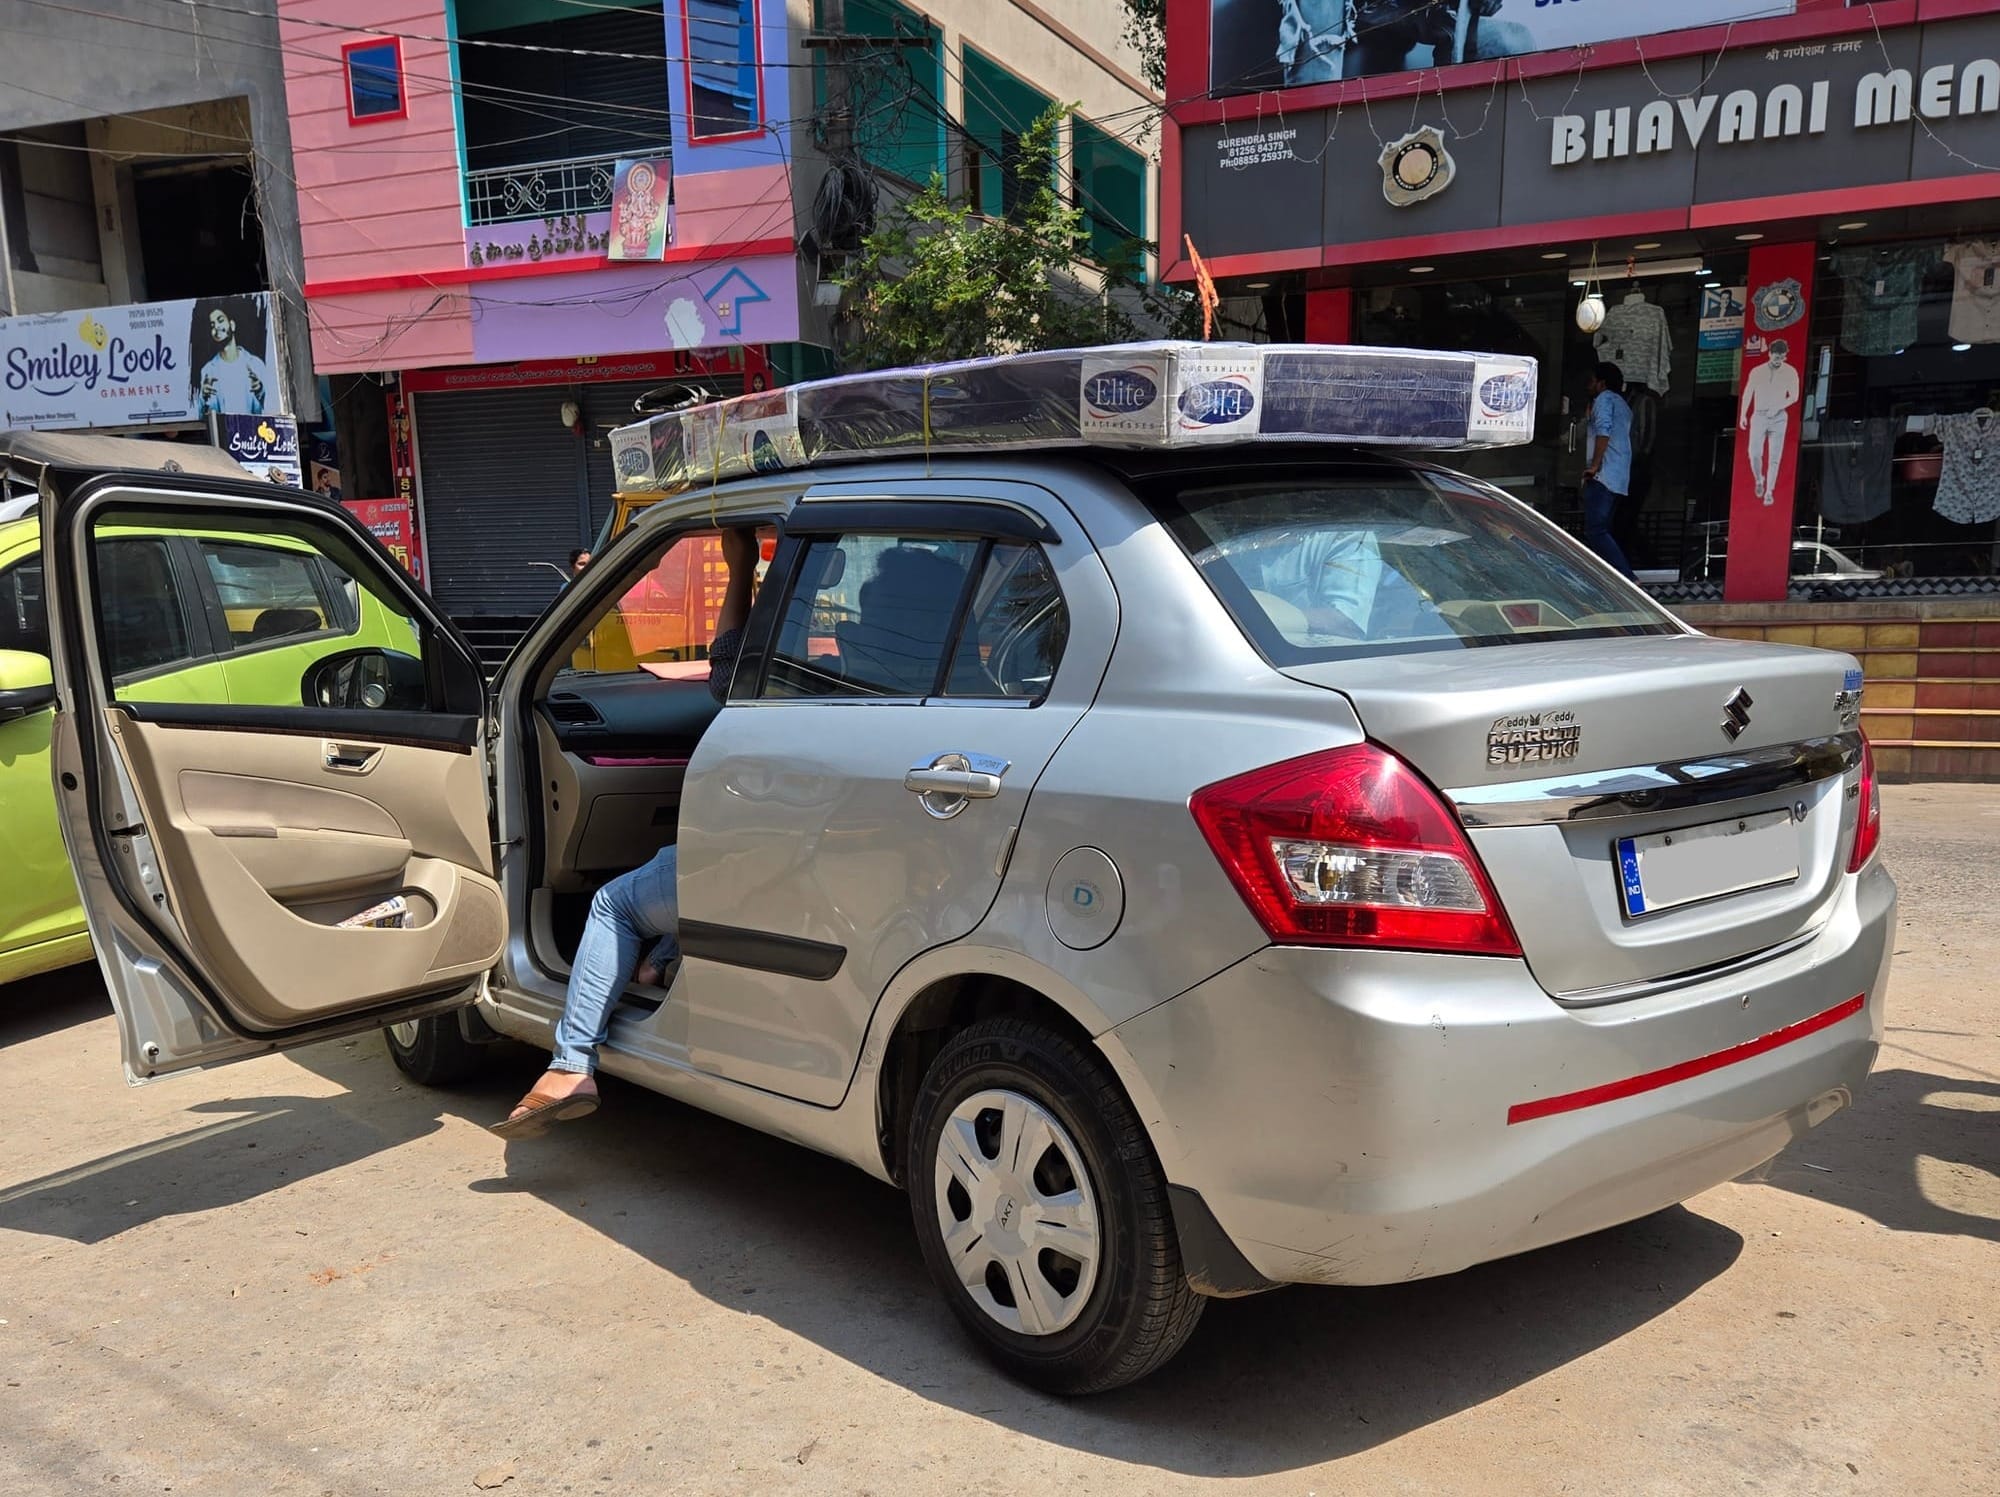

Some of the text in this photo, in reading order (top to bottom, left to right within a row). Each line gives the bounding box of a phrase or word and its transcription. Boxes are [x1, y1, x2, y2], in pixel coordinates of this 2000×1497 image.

[1551, 59, 2000, 165] BHAVANI MEN
[1217, 129, 1297, 149] SURENDRA SINGH
[1257, 141, 1284, 153] 84379
[1261, 149, 1293, 163] 259379
[6, 334, 176, 390] Smiley Look
[101, 384, 171, 398] GARMENTS
[1095, 378, 1145, 406] Elite
[229, 432, 297, 458] Smiley Look
[1488, 725, 1581, 745] MARUTI
[1488, 740, 1580, 764] SUZUKI
[1073, 886, 1094, 906] D
[1627, 885, 1641, 896] IND
[1001, 1199, 1013, 1231] AKT
